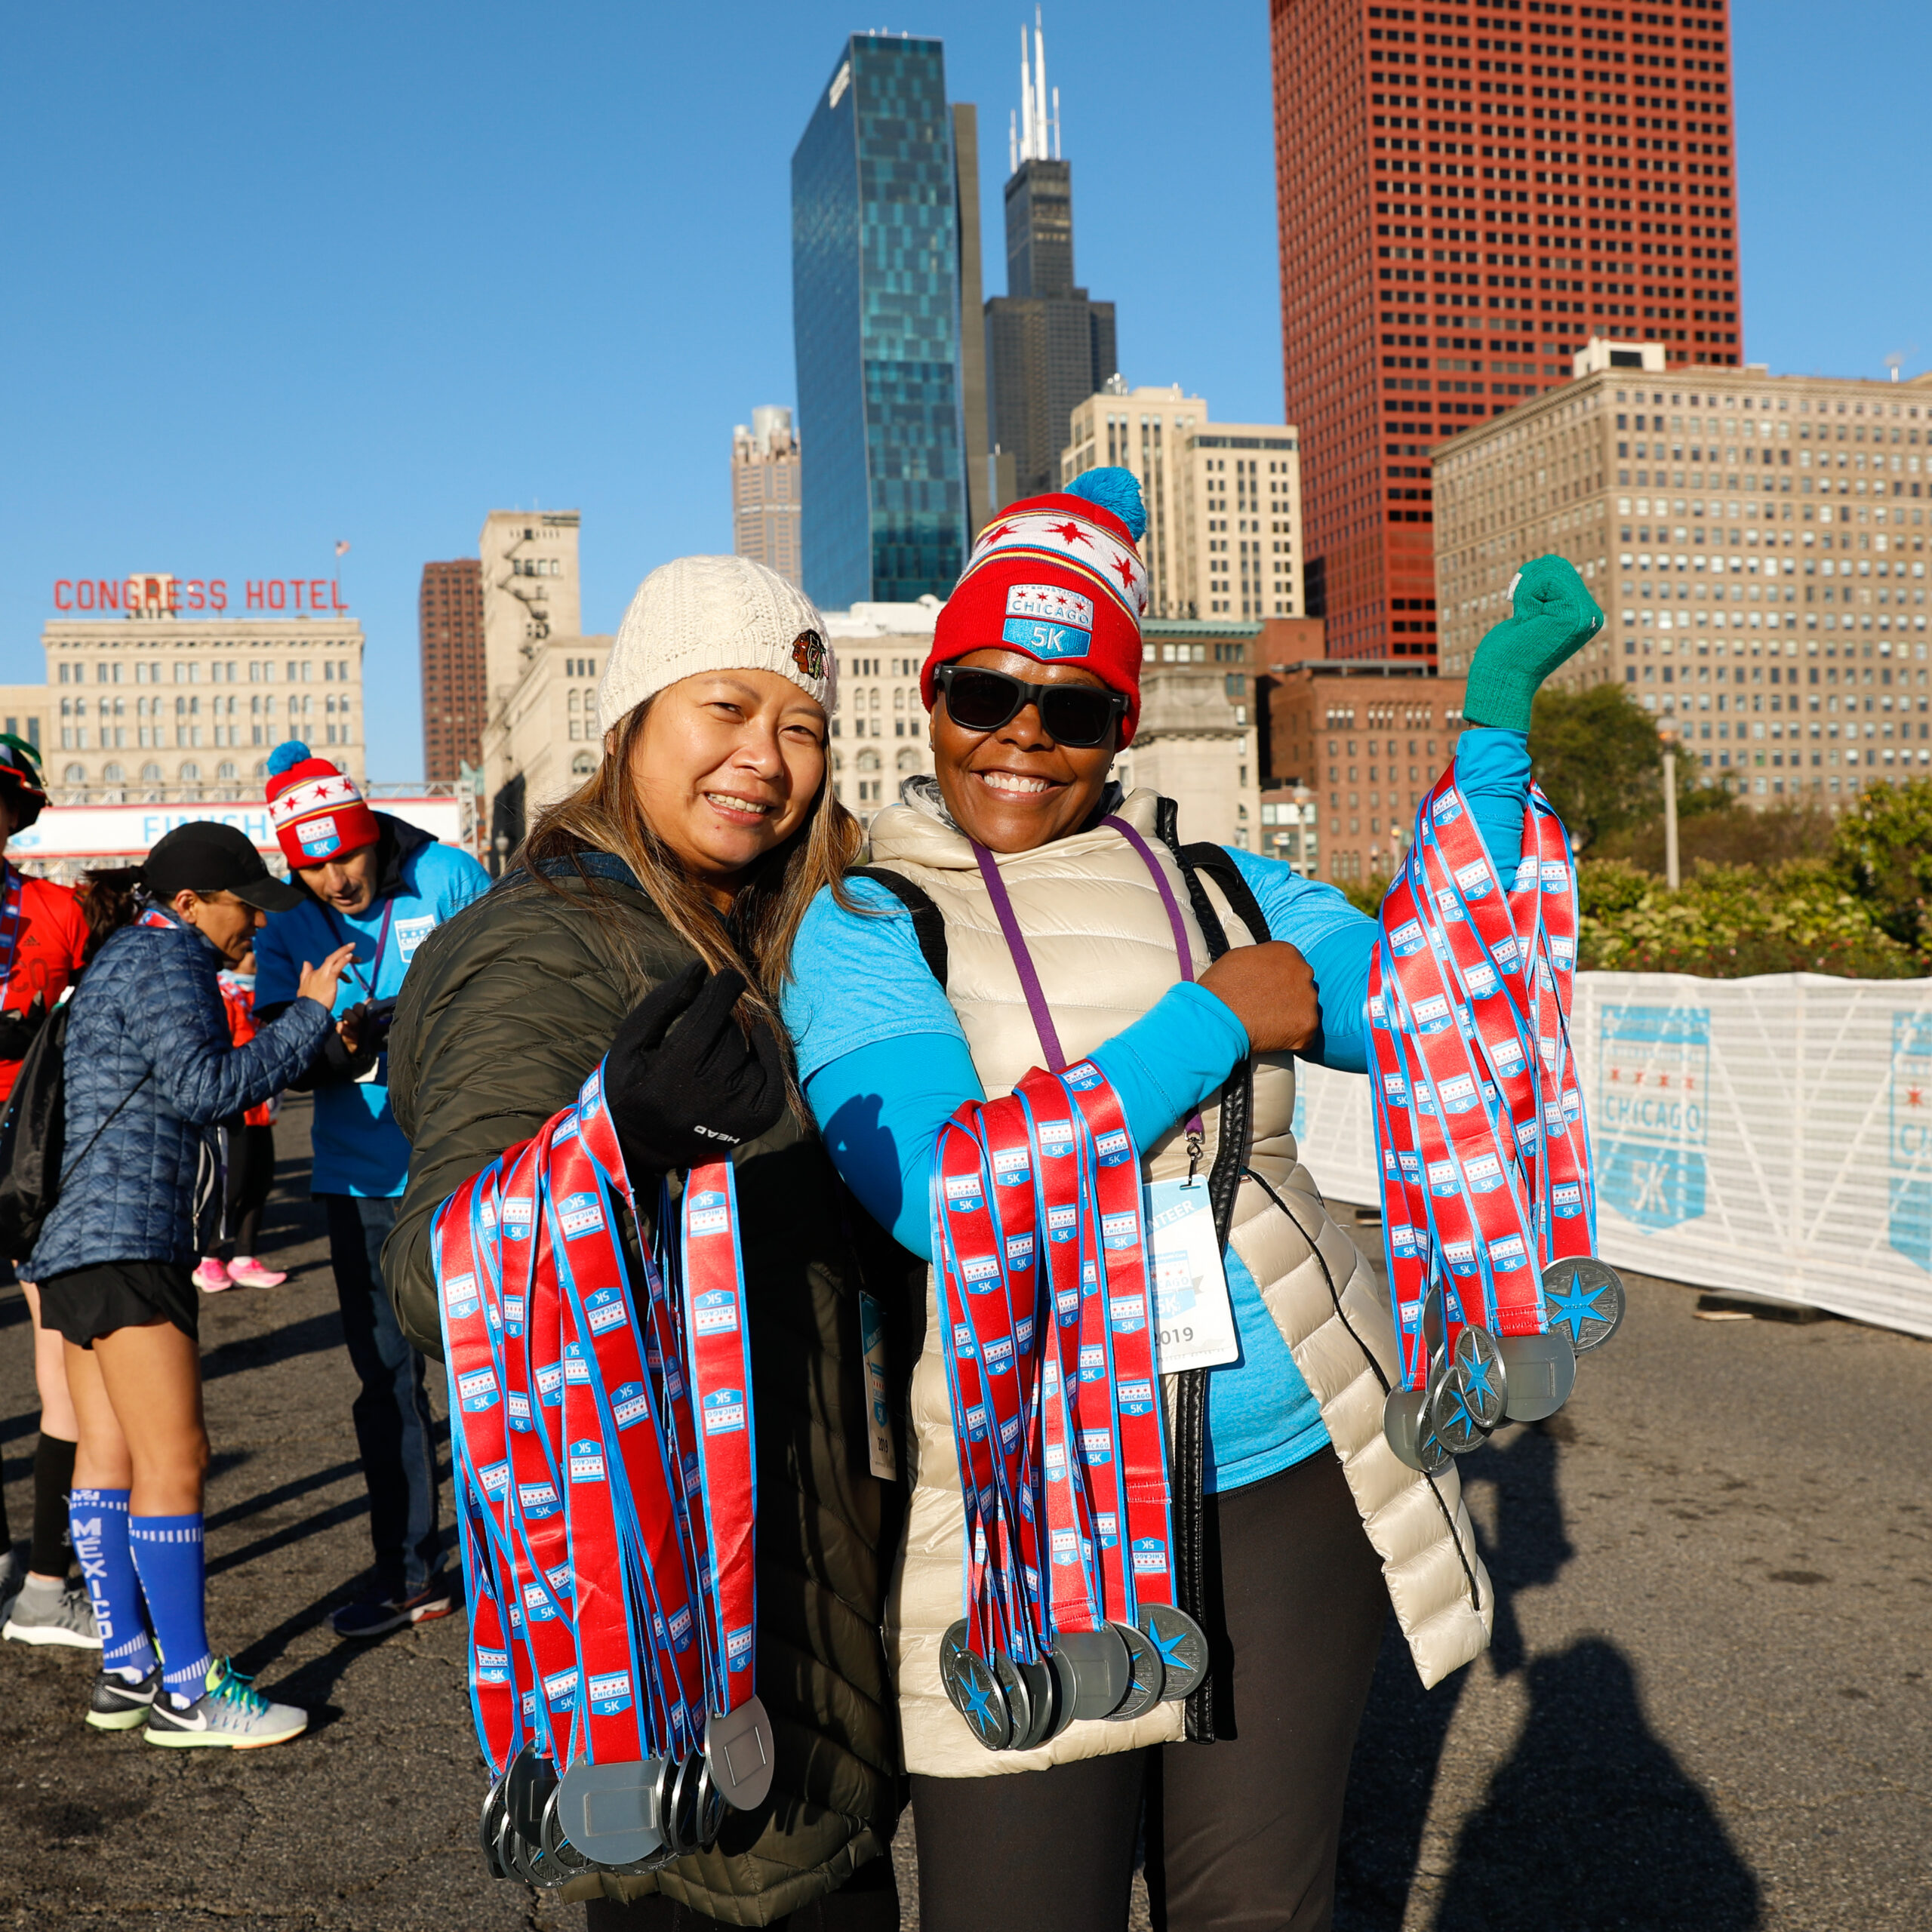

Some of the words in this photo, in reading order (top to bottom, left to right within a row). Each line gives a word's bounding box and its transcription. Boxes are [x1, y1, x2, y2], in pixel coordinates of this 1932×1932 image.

[54, 580, 227, 611] CONGRESS
[246, 580, 349, 610] HOTEL
[1012, 600, 1089, 625] CHICAGO
[1031, 626, 1066, 651] 5K
[1434, 798, 1457, 815] CHICAGO
[1443, 811, 1454, 823] 5K
[143, 814, 266, 843] FIH
[301, 827, 337, 841] CHICAGO
[314, 841, 331, 854] 5K
[1462, 872, 1488, 889] CHICAGO
[1518, 881, 1531, 891] 5K
[1474, 884, 1487, 898] 5K
[1546, 883, 1559, 892] 5K
[1443, 900, 1458, 909] CHIC
[1393, 930, 1420, 946] CHICAGO
[1404, 941, 1417, 954] 5K
[1498, 949, 1517, 963] CHICAGO
[1509, 960, 1518, 972] 5K
[1558, 960, 1567, 969] 5K
[1481, 986, 1494, 997] 5K
[1418, 1008, 1447, 1022] CHICAGO
[1429, 1020, 1443, 1032] 5K
[1497, 1052, 1521, 1066] CHICAGO
[1507, 1064, 1519, 1075] 5K
[1067, 1070, 1096, 1084] CHICAGO
[1081, 1079, 1096, 1090] 5K
[1444, 1088, 1473, 1101] CHICAGO
[1456, 1100, 1469, 1111] 5K
[1605, 1095, 1701, 1133] CHICAGO
[694, 1124, 740, 1144] HEAD
[1052, 1146, 1066, 1155] 5K
[1100, 1143, 1128, 1155] CHICAGO
[1108, 1155, 1121, 1165] 5K
[996, 1162, 1028, 1171] CHICAGO
[1007, 1174, 1020, 1184] 5K
[1411, 1174, 1420, 1182] 5K
[1432, 1174, 1455, 1183] CHICAG
[1469, 1167, 1499, 1180] CHICAGO
[1481, 1179, 1494, 1190] 5K
[1630, 1158, 1670, 1216] 5K
[949, 1188, 980, 1198] CHICAGO
[1441, 1186, 1455, 1195] 5K
[569, 1195, 586, 1209] 5K
[700, 1194, 714, 1206] 5K
[1555, 1195, 1579, 1204] CHICAGO
[960, 1200, 974, 1211] 5K
[563, 1208, 599, 1224] CHICAGO
[691, 1208, 725, 1220] CHICAGO
[1147, 1200, 1195, 1229] NTEER
[1563, 1206, 1574, 1217] 5K
[1051, 1219, 1075, 1228] CHICAGO
[512, 1227, 522, 1238] 5K
[1058, 1230, 1069, 1241] 5K
[1105, 1225, 1135, 1235] CHICAGO
[1114, 1237, 1128, 1248] 5K
[1395, 1236, 1414, 1244] CHICA
[1008, 1246, 1032, 1257] CHICAGO
[1404, 1247, 1417, 1256] 5K
[1493, 1247, 1523, 1260] CHICAGO
[1017, 1258, 1027, 1269] 5K
[1503, 1258, 1518, 1269] 5K
[967, 1269, 998, 1281] CHICAGO
[1460, 1265, 1472, 1274] 5K
[978, 1281, 992, 1292] 5K
[596, 1291, 610, 1305] 5K
[706, 1292, 722, 1306] 5K
[457, 1303, 471, 1316] 5K
[590, 1303, 622, 1320] CHICAGO
[697, 1307, 734, 1319] CHICAGO
[1060, 1303, 1078, 1313] CHICAGO
[1112, 1309, 1143, 1319] CHICAGO
[1065, 1315, 1072, 1325] 5K
[509, 1324, 518, 1334] 5K
[1121, 1321, 1135, 1331] 5K
[957, 1334, 971, 1345] CHIC
[571, 1345, 580, 1355] 5K
[987, 1349, 1011, 1363] CHICAGO
[995, 1361, 1007, 1372] 5K
[1082, 1371, 1096, 1380] 5K
[463, 1381, 494, 1398] CHICAGO
[542, 1380, 561, 1392] CHIC
[555, 1392, 561, 1402] 5
[619, 1385, 634, 1399] 5K
[474, 1396, 489, 1410] 5K
[715, 1392, 731, 1404] 5K
[616, 1396, 645, 1414] CHICAGO
[1131, 1404, 1144, 1413] 5K
[509, 1407, 529, 1416] CHICAGO
[707, 1405, 741, 1417] CHICAGO
[515, 1420, 525, 1431] 5K
[969, 1417, 986, 1429] CHICAG
[976, 1429, 984, 1440] 5K
[578, 1443, 592, 1454] 5K
[877, 1436, 888, 1453] 2019
[1010, 1441, 1016, 1452] 5K
[1089, 1454, 1102, 1463] 5K
[1051, 1469, 1060, 1479] 5K
[486, 1475, 509, 1488] CHICA
[523, 1496, 555, 1506] CHICAGO
[536, 1506, 551, 1517] 5K
[1097, 1537, 1108, 1547] 5K
[1142, 1540, 1155, 1550] 5K
[1061, 1553, 1072, 1563] 5K
[554, 1575, 570, 1588] CHIC
[528, 1596, 547, 1607] CHIC
[540, 1606, 555, 1618] 5K
[672, 1621, 690, 1639] CHICAGO
[681, 1636, 689, 1648] 5K
[730, 1642, 750, 1656] CHICAGO
[737, 1656, 746, 1669] 5K
[491, 1669, 504, 1680] 5K
[550, 1684, 575, 1699] CHICAG
[592, 1687, 628, 1700] CHICAGO
[561, 1697, 575, 1709] 5K
[604, 1700, 620, 1713] 5K
